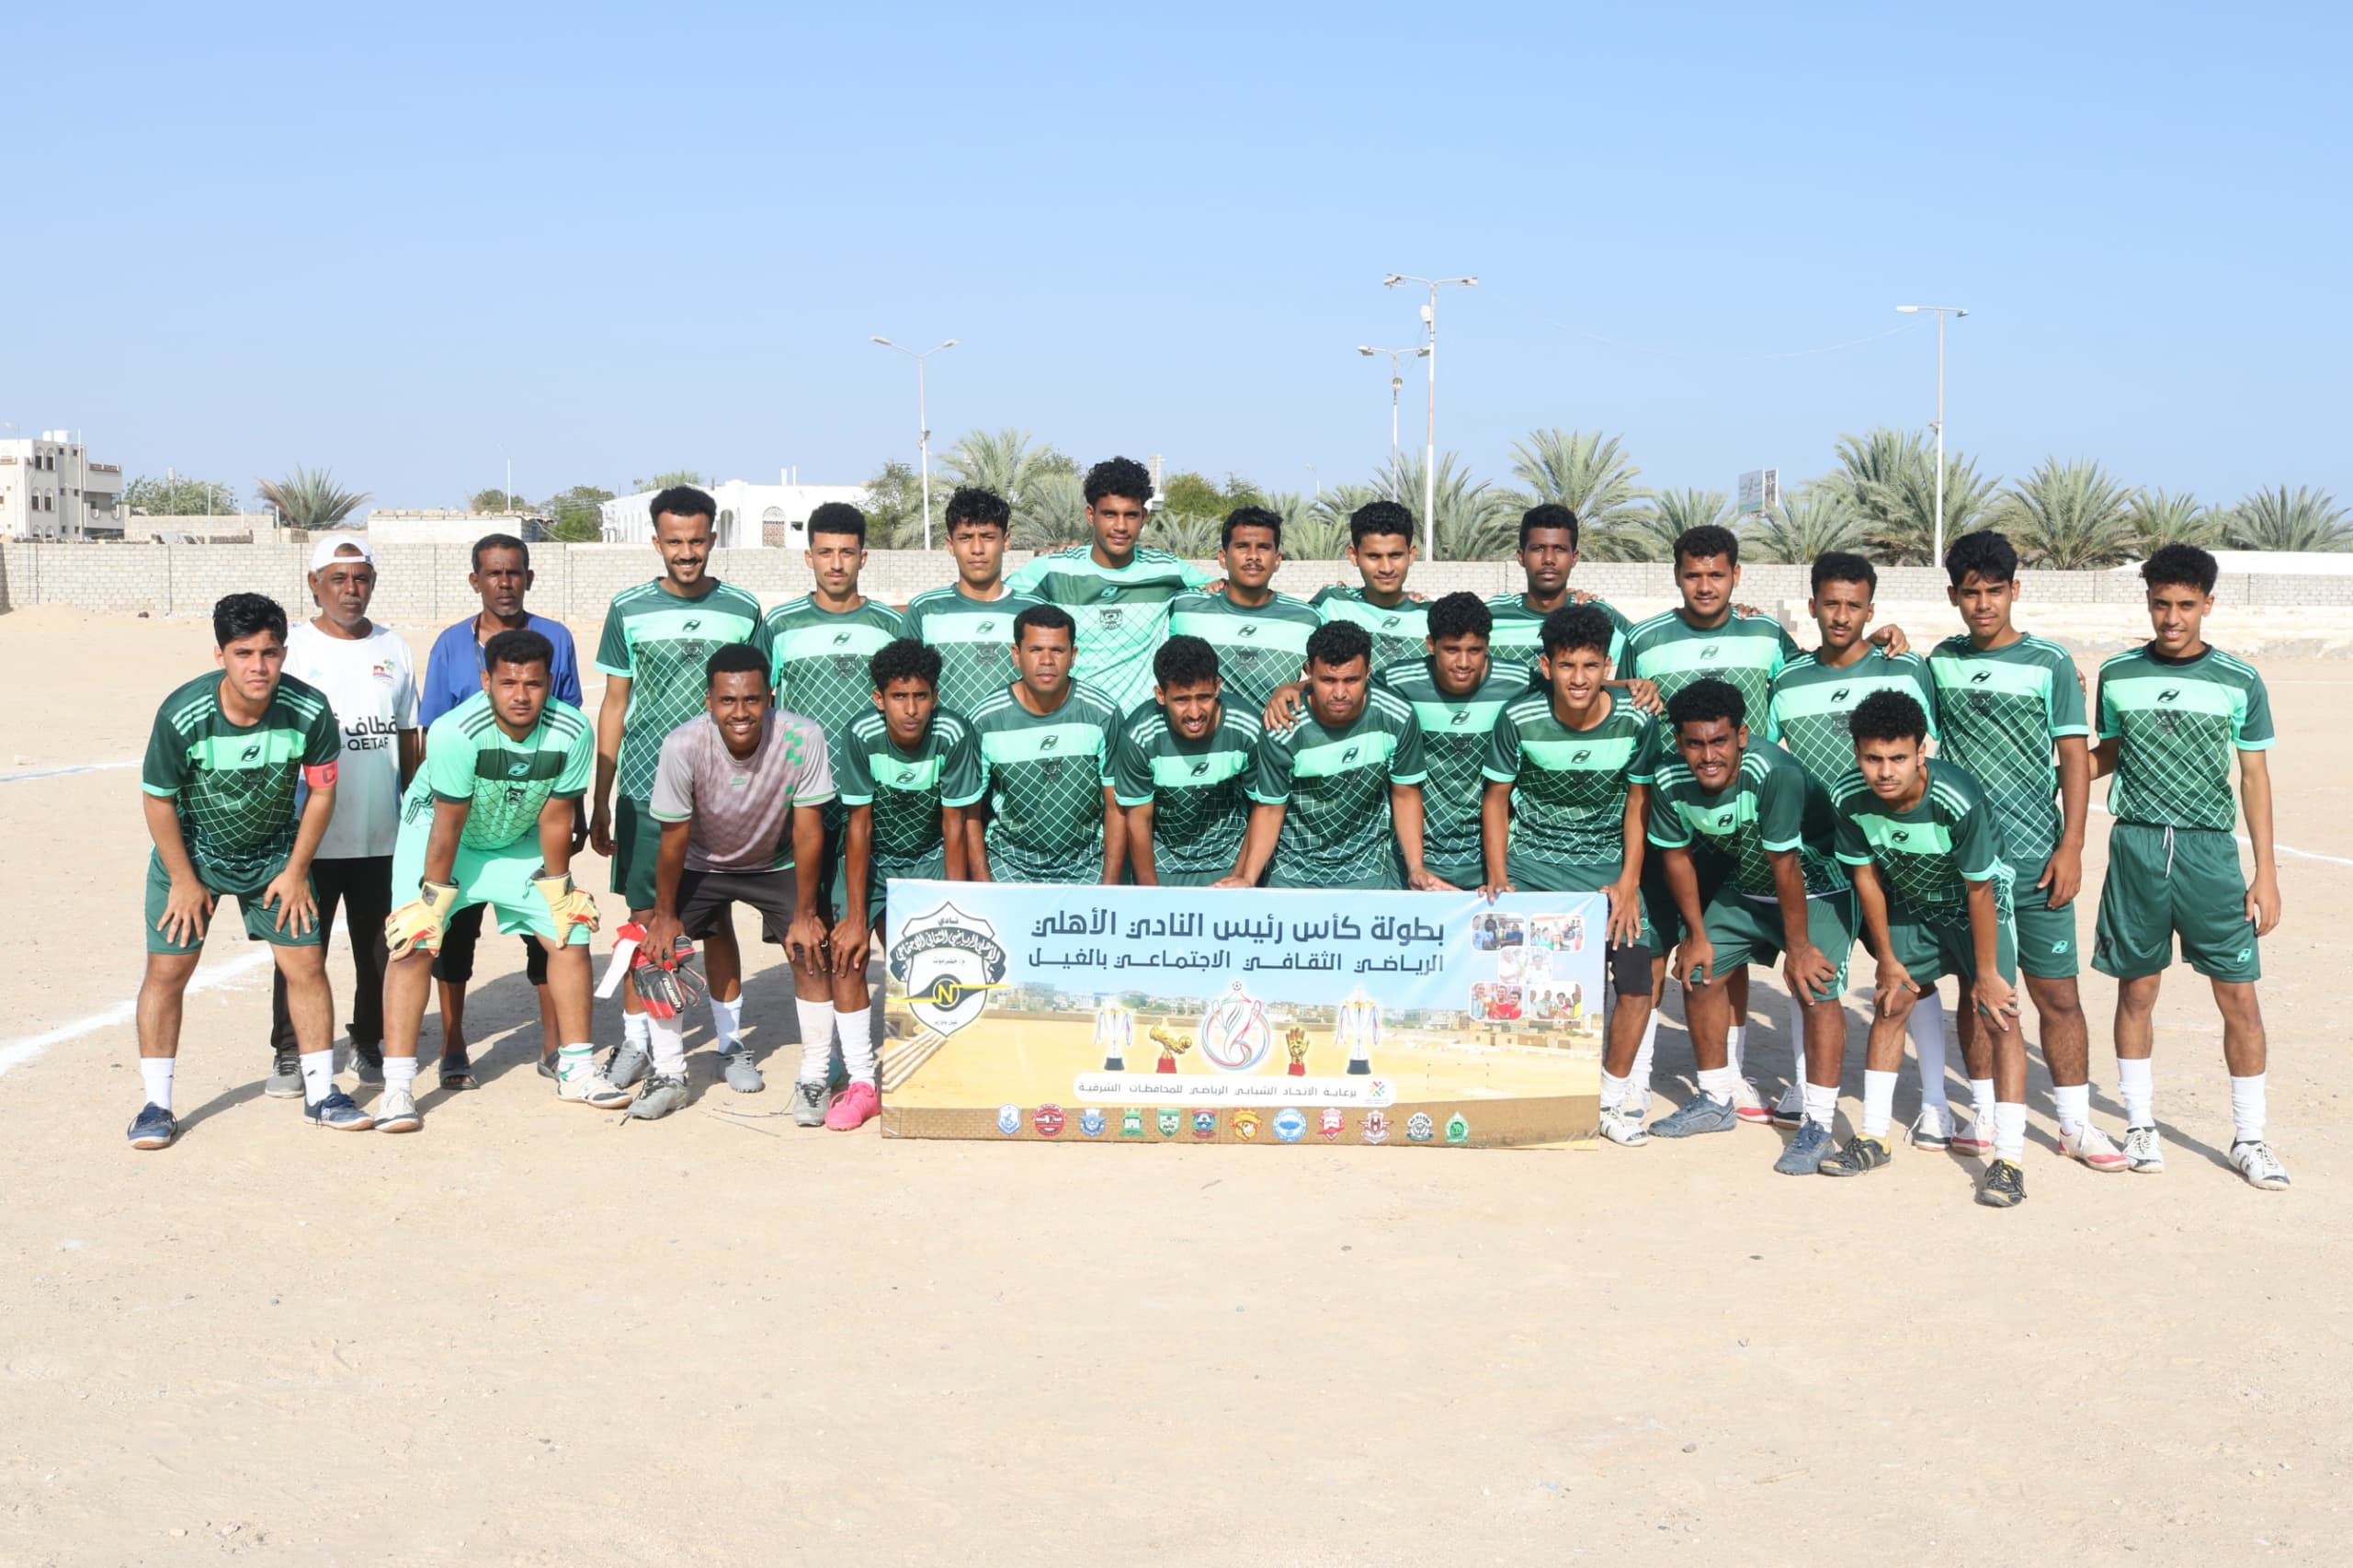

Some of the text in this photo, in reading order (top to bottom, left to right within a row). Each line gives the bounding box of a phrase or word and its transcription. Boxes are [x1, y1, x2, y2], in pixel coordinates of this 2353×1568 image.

[347, 737, 390, 751] QETAF
[1031, 907, 1445, 947] بطولة كأس رئيس النادي الأهلي
[1029, 948, 1444, 976] الرياضي الثقافي الاجتماعي بالغيل
[1078, 1082, 1358, 1098] برعاية الاتحاد الشبابي الرياضي للمحافظات الشرقية
